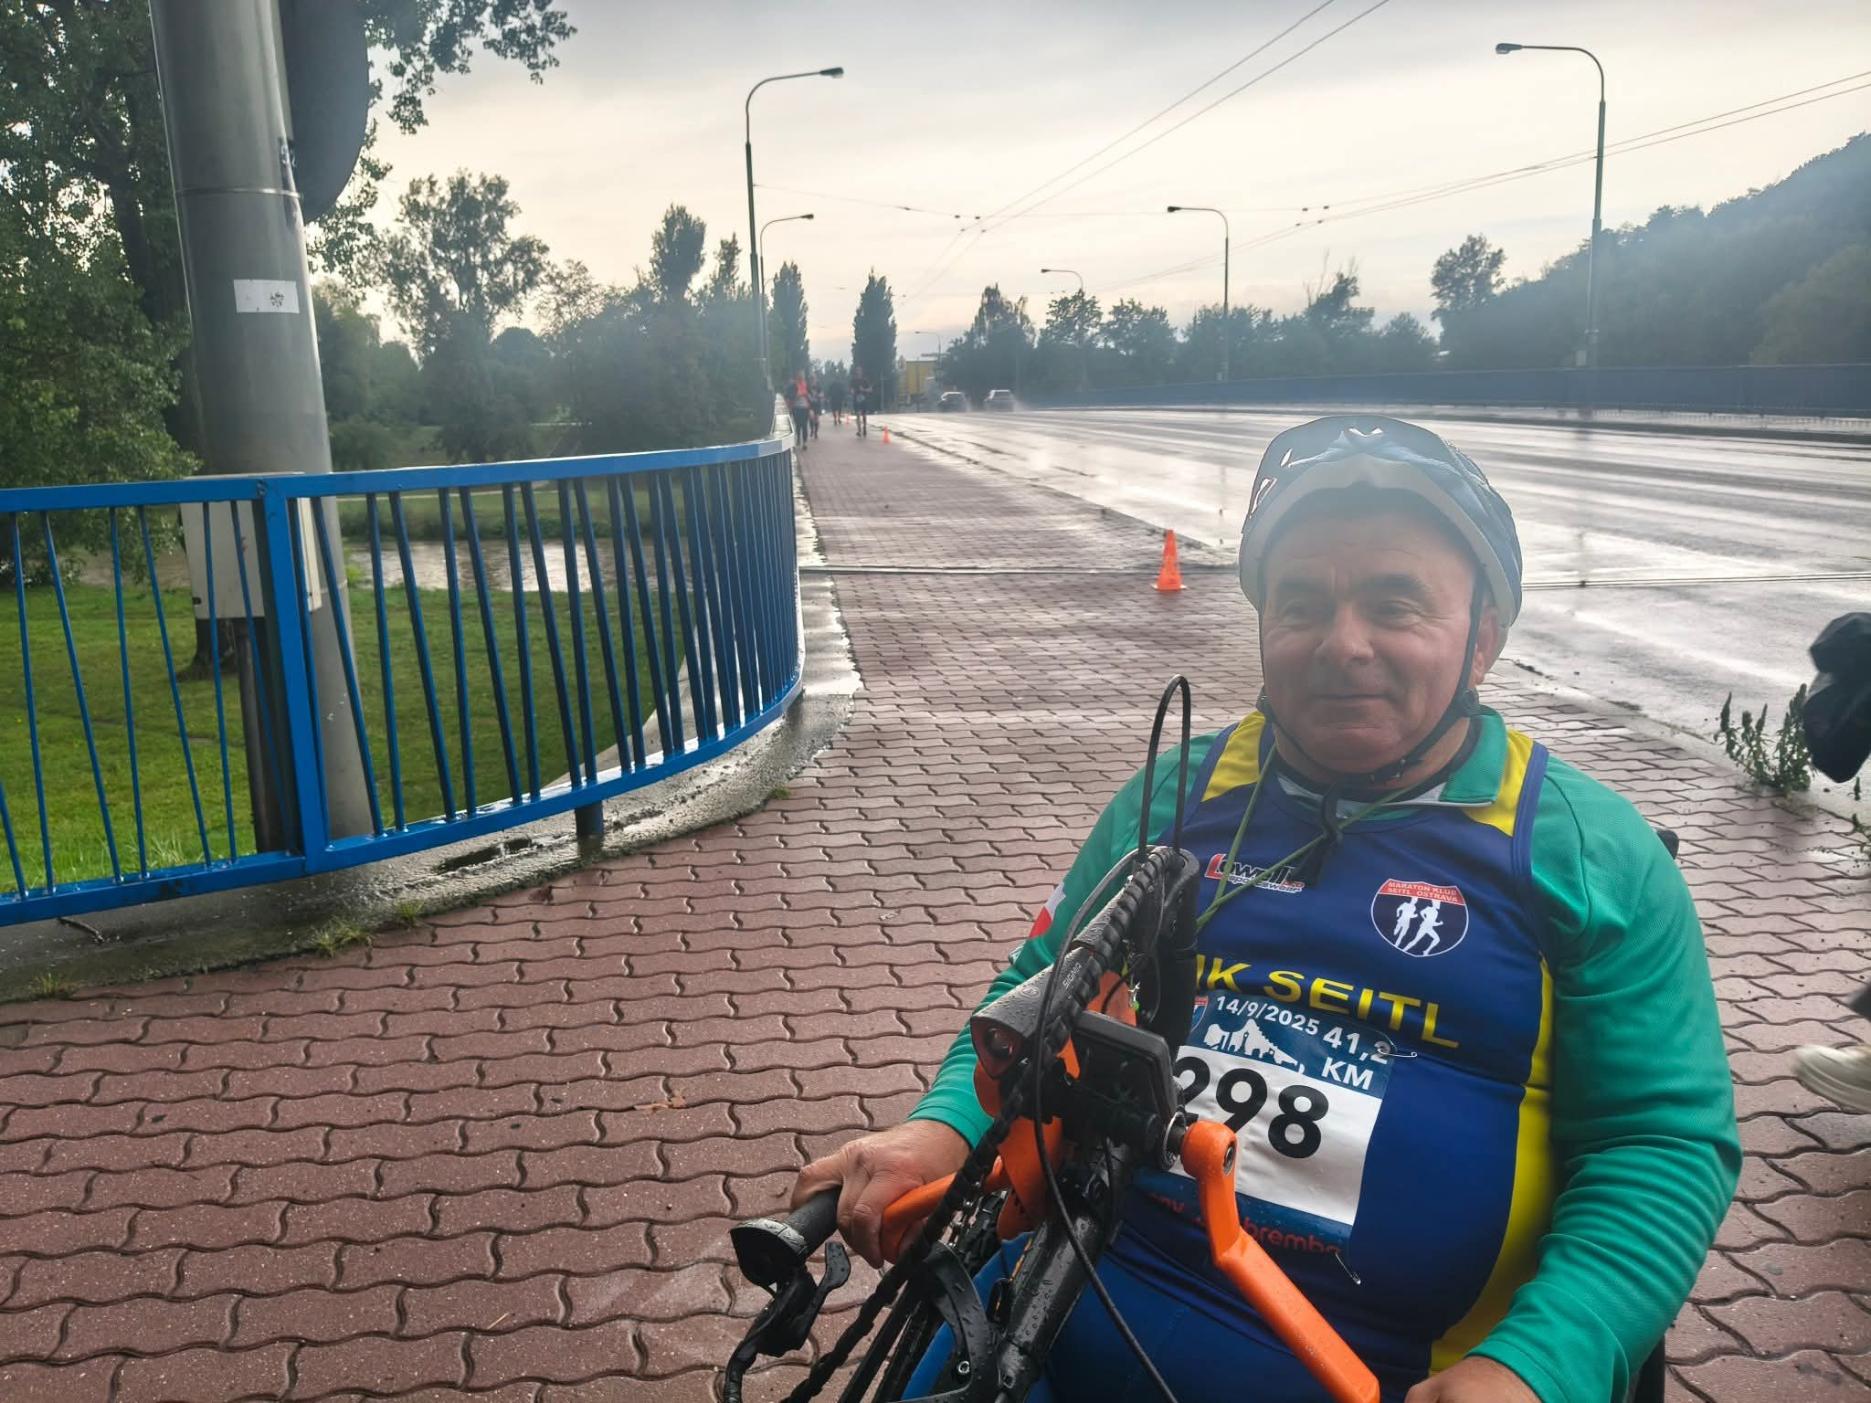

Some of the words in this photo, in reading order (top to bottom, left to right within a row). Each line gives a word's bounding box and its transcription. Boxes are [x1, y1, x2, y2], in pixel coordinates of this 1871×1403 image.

[1387, 887, 1411, 895] SEITL
[1416, 890, 1458, 903] OSTRAVA
[1388, 882, 1430, 892] MARATON
[1432, 887, 1457, 896] KLUB
[1062, 962, 1082, 990] SIGMA
[1216, 996, 1321, 1037] 14/9/2025
[1263, 969, 1459, 1049] SEITL
[1322, 1026, 1392, 1065] 41,2
[1321, 1056, 1374, 1090] KM
[1173, 1056, 1330, 1159] 298
